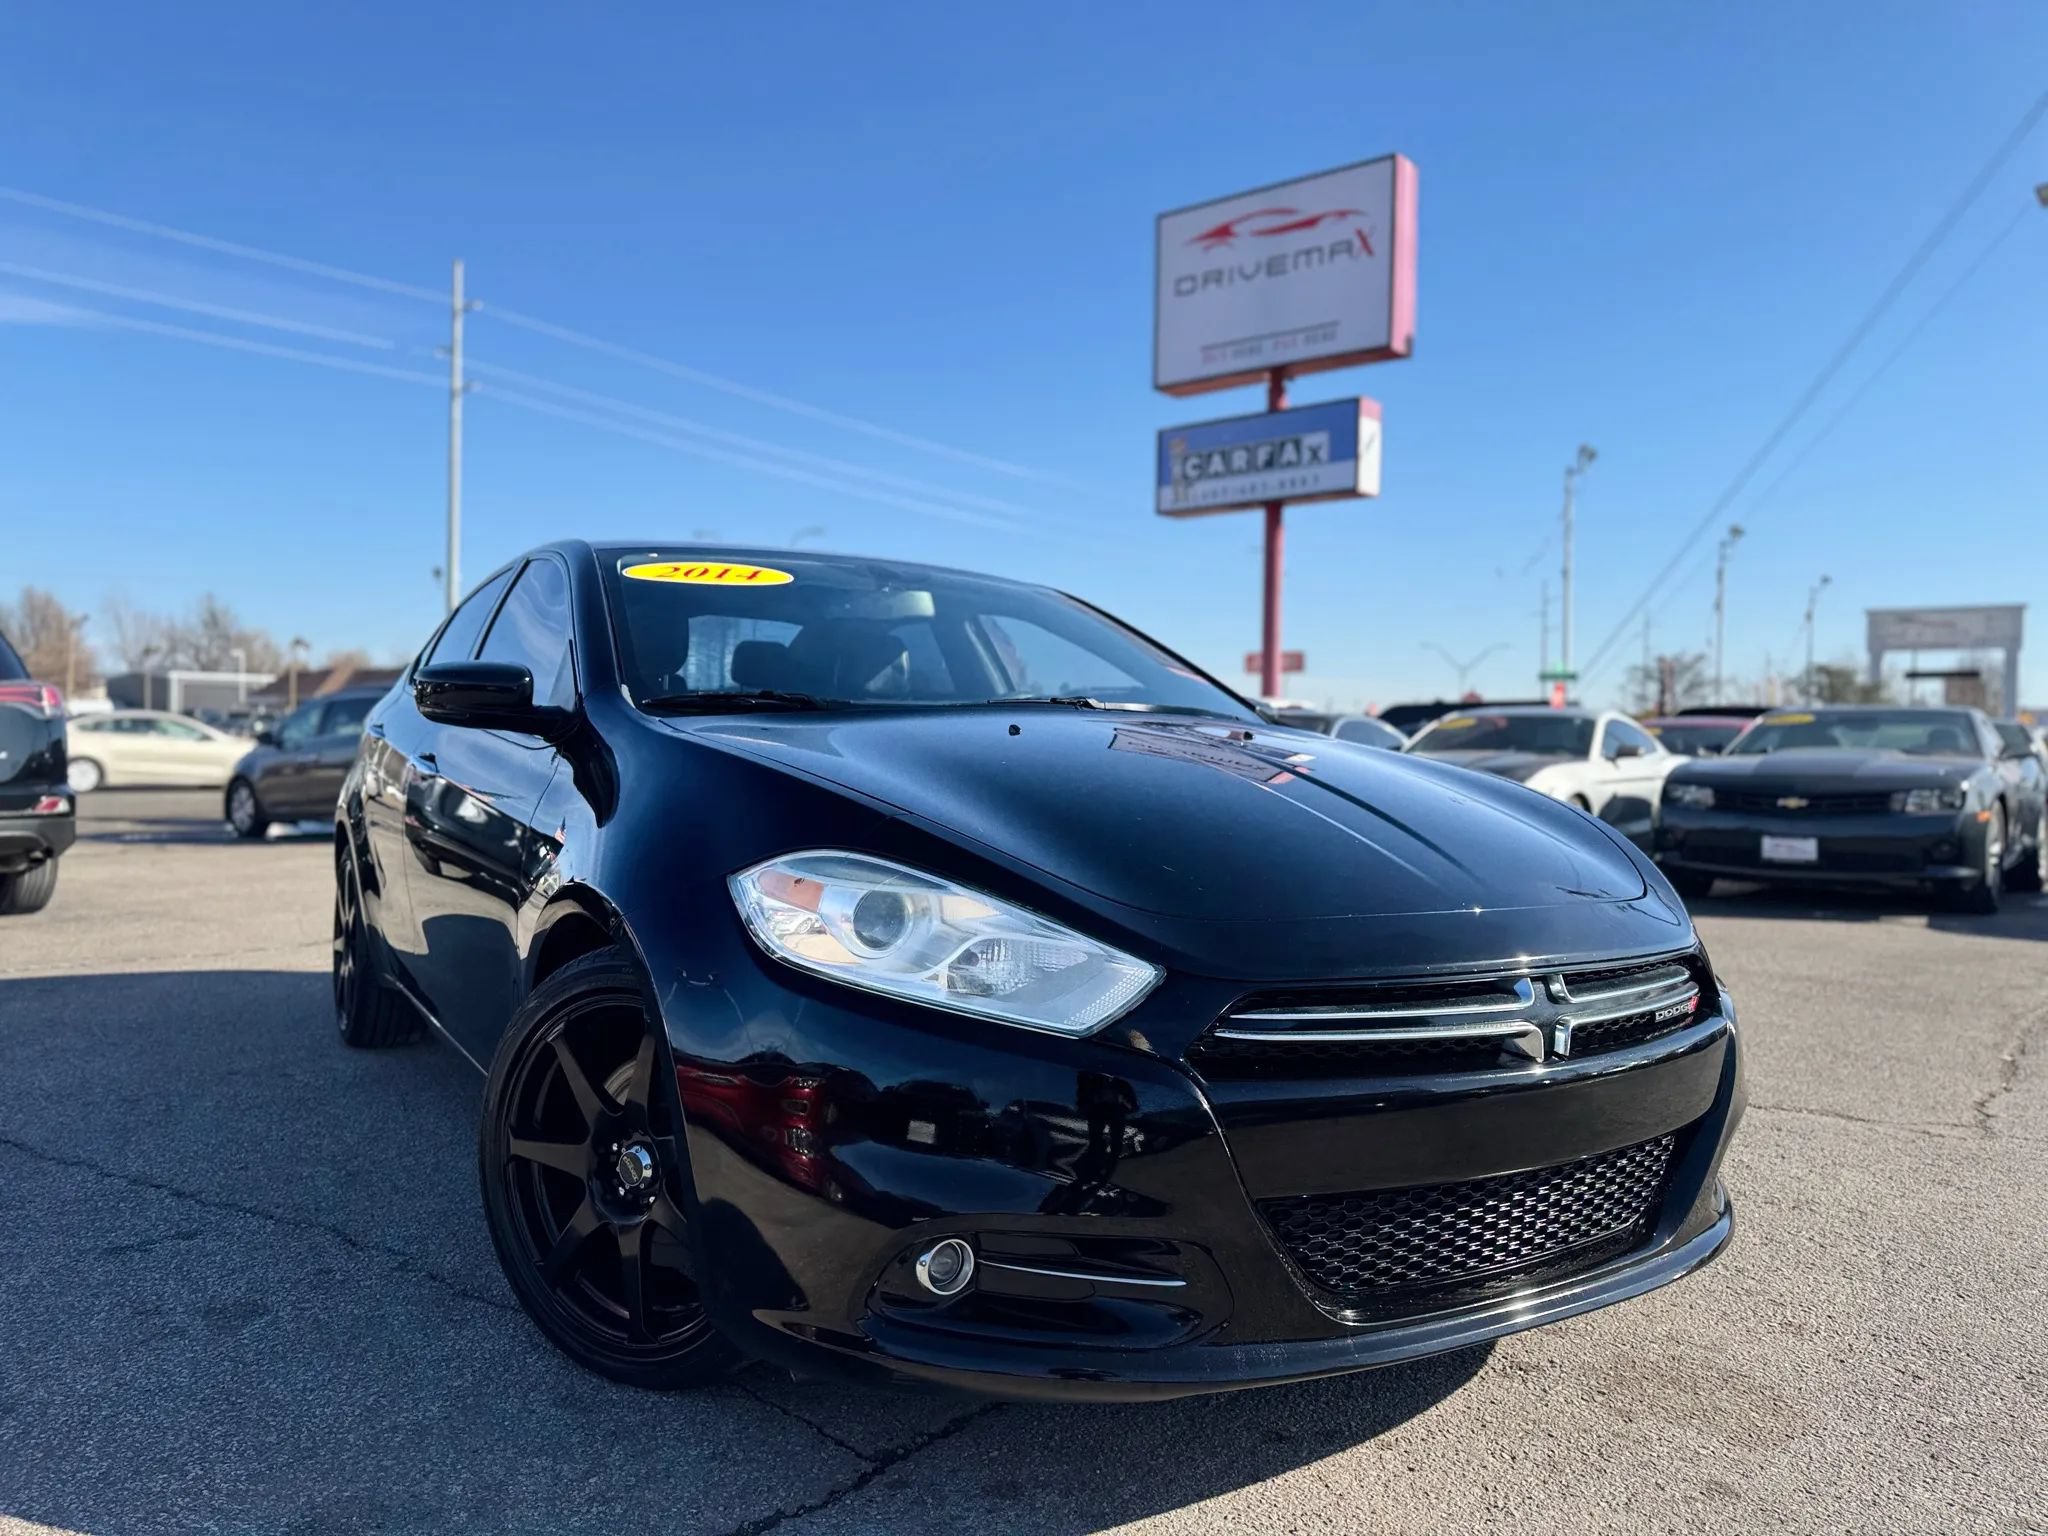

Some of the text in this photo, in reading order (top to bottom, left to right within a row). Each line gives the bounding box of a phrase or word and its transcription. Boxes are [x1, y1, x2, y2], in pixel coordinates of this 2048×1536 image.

[1173, 226, 1376, 297] DRIVEMAX
[1184, 437, 1327, 478] CARFAX
[656, 566, 763, 580] 2014
